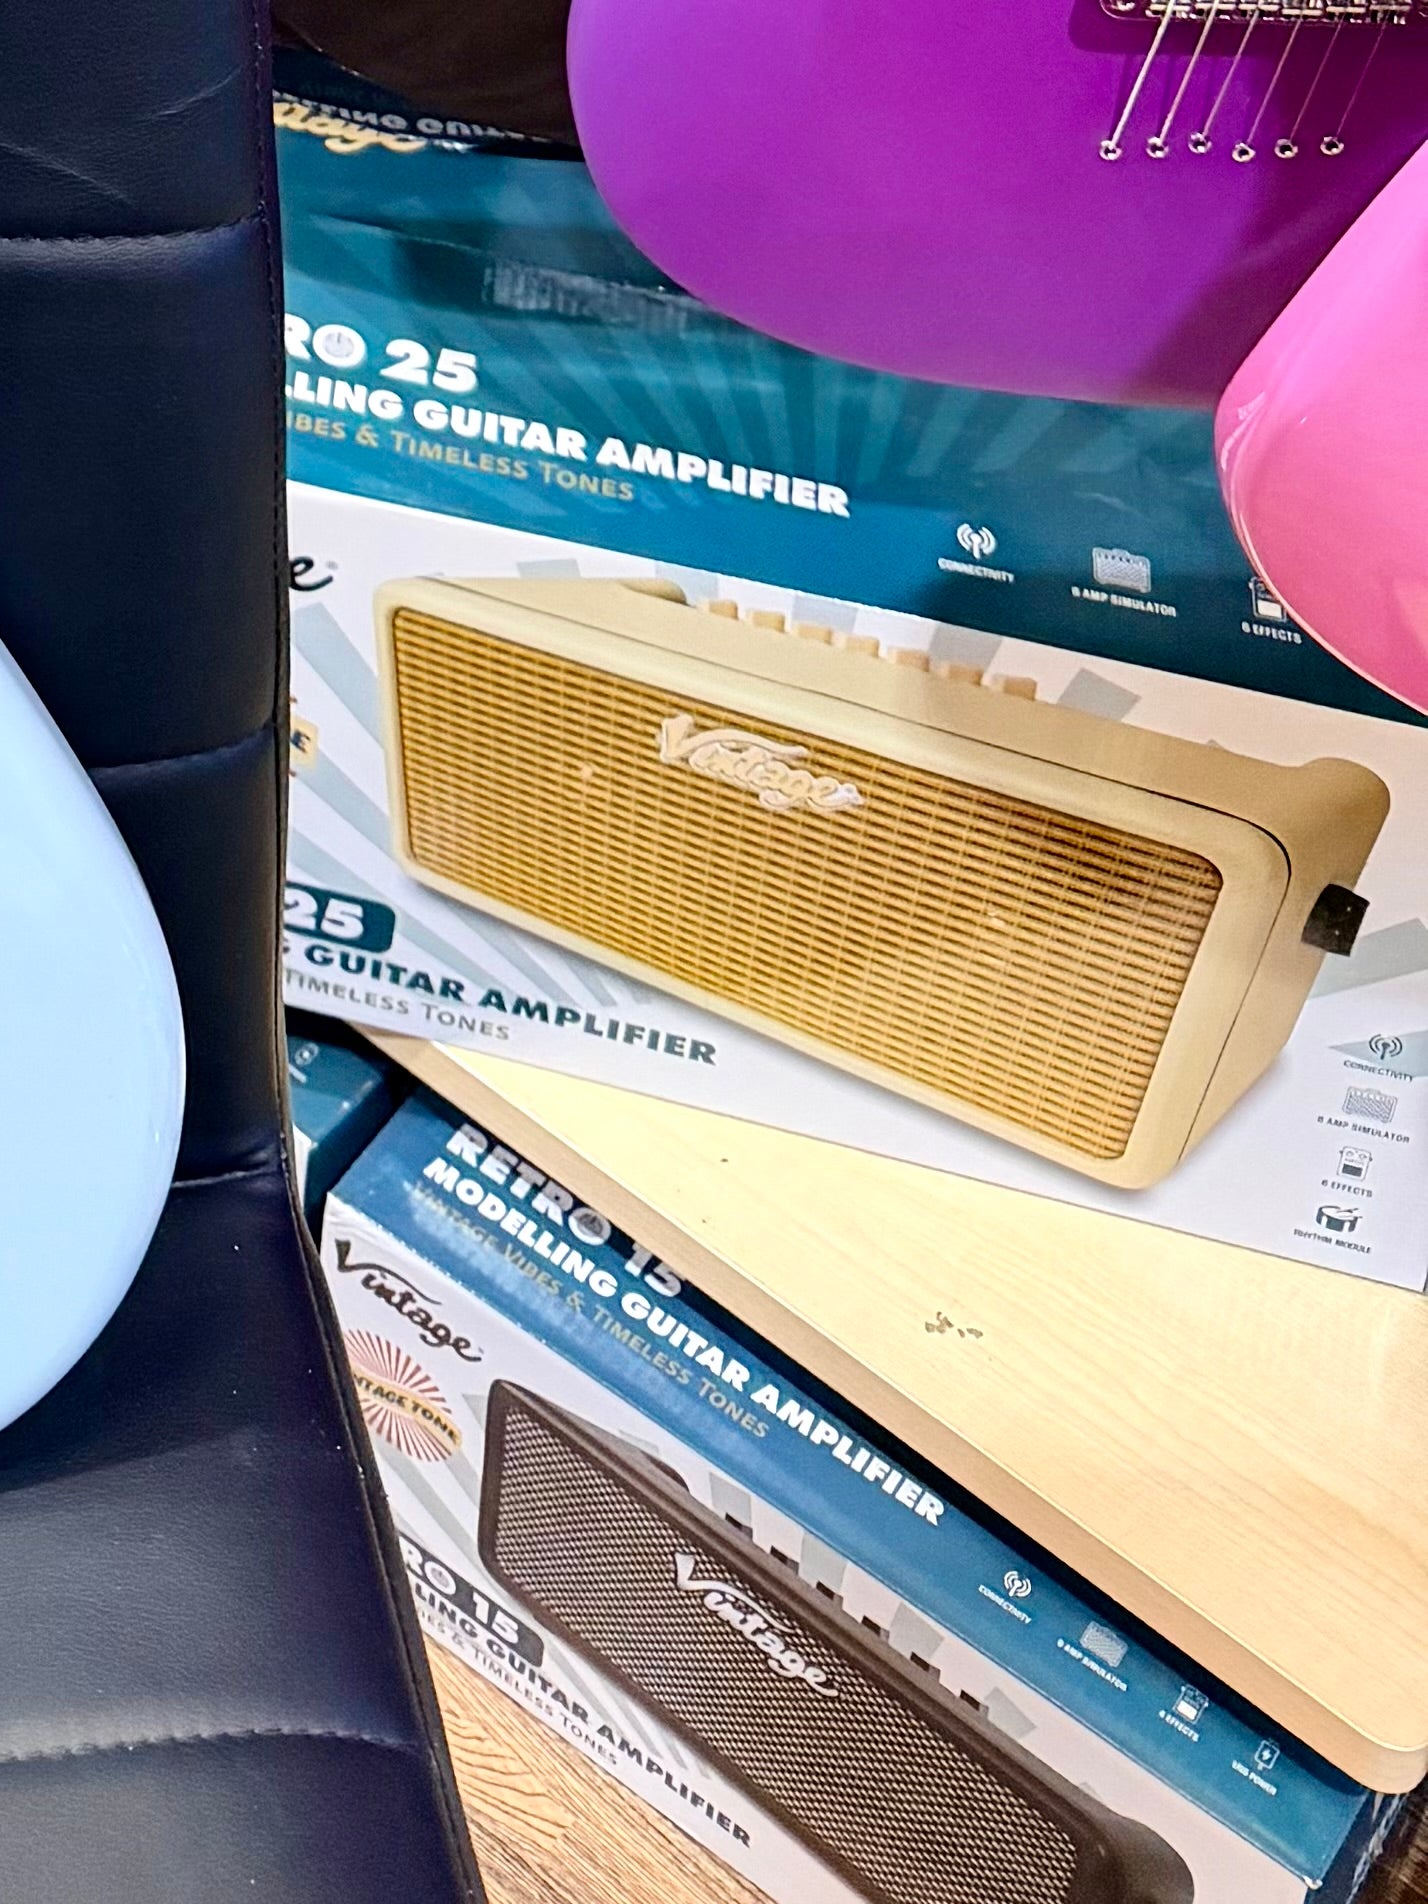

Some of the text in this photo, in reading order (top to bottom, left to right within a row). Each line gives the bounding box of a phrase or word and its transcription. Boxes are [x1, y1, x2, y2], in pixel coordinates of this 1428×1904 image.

[380, 338, 478, 393] 25
[390, 432, 634, 501] TIMELESS TONES
[413, 399, 850, 518] GUITAR AMPLIFIER
[938, 557, 1015, 583] CONNECTIVITY
[657, 713, 864, 812] Vintage
[286, 969, 510, 1041] TIMELESS TONES
[305, 943, 718, 1066] GUITAR AMPLIFIER
[1343, 1059, 1414, 1082] CONNECTIVITY
[445, 1123, 690, 1300] RETRO 15
[335, 1238, 482, 1362] Vintage
[422, 1158, 947, 1527] MODELLING GUITAR AMPLIFIER
[410, 1399, 460, 1445] TONE
[592, 1306, 770, 1440] TIMELESS TONES
[672, 1550, 840, 1699] Vintage
[488, 1638, 753, 1850] GUITAR AMPLIFIER
